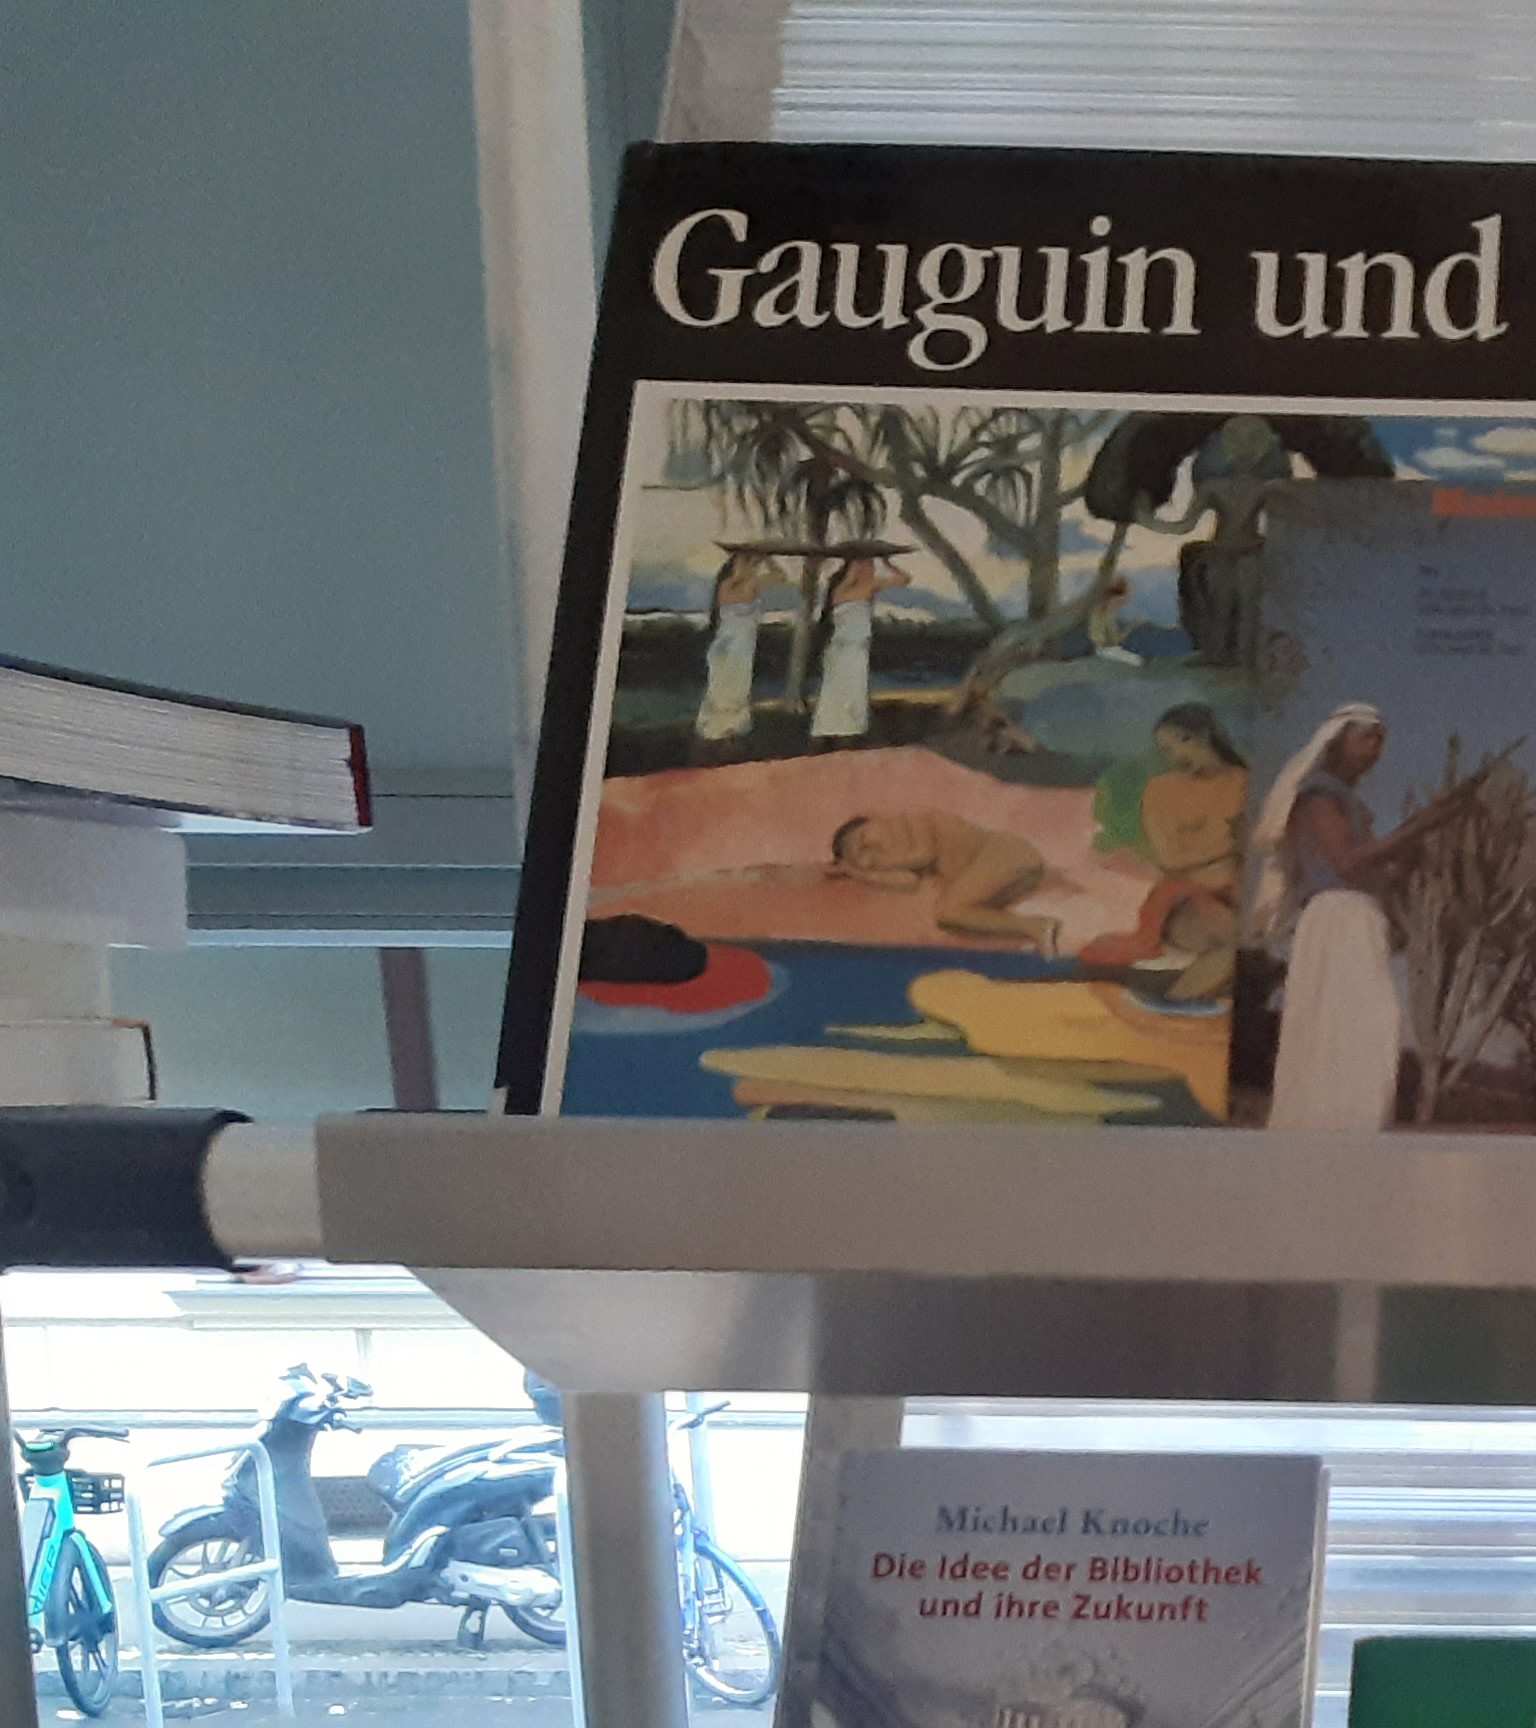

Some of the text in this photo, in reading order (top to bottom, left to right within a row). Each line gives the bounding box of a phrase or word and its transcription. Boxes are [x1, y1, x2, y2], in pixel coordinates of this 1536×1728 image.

[652, 209, 1201, 371] Gauguin
[1250, 214, 1508, 342] und
[936, 1505, 1209, 1538] Michael Knoche
[871, 1552, 1262, 1586] Die Idee der Bibliothek
[919, 1591, 1208, 1623] und ihre Zukunft
